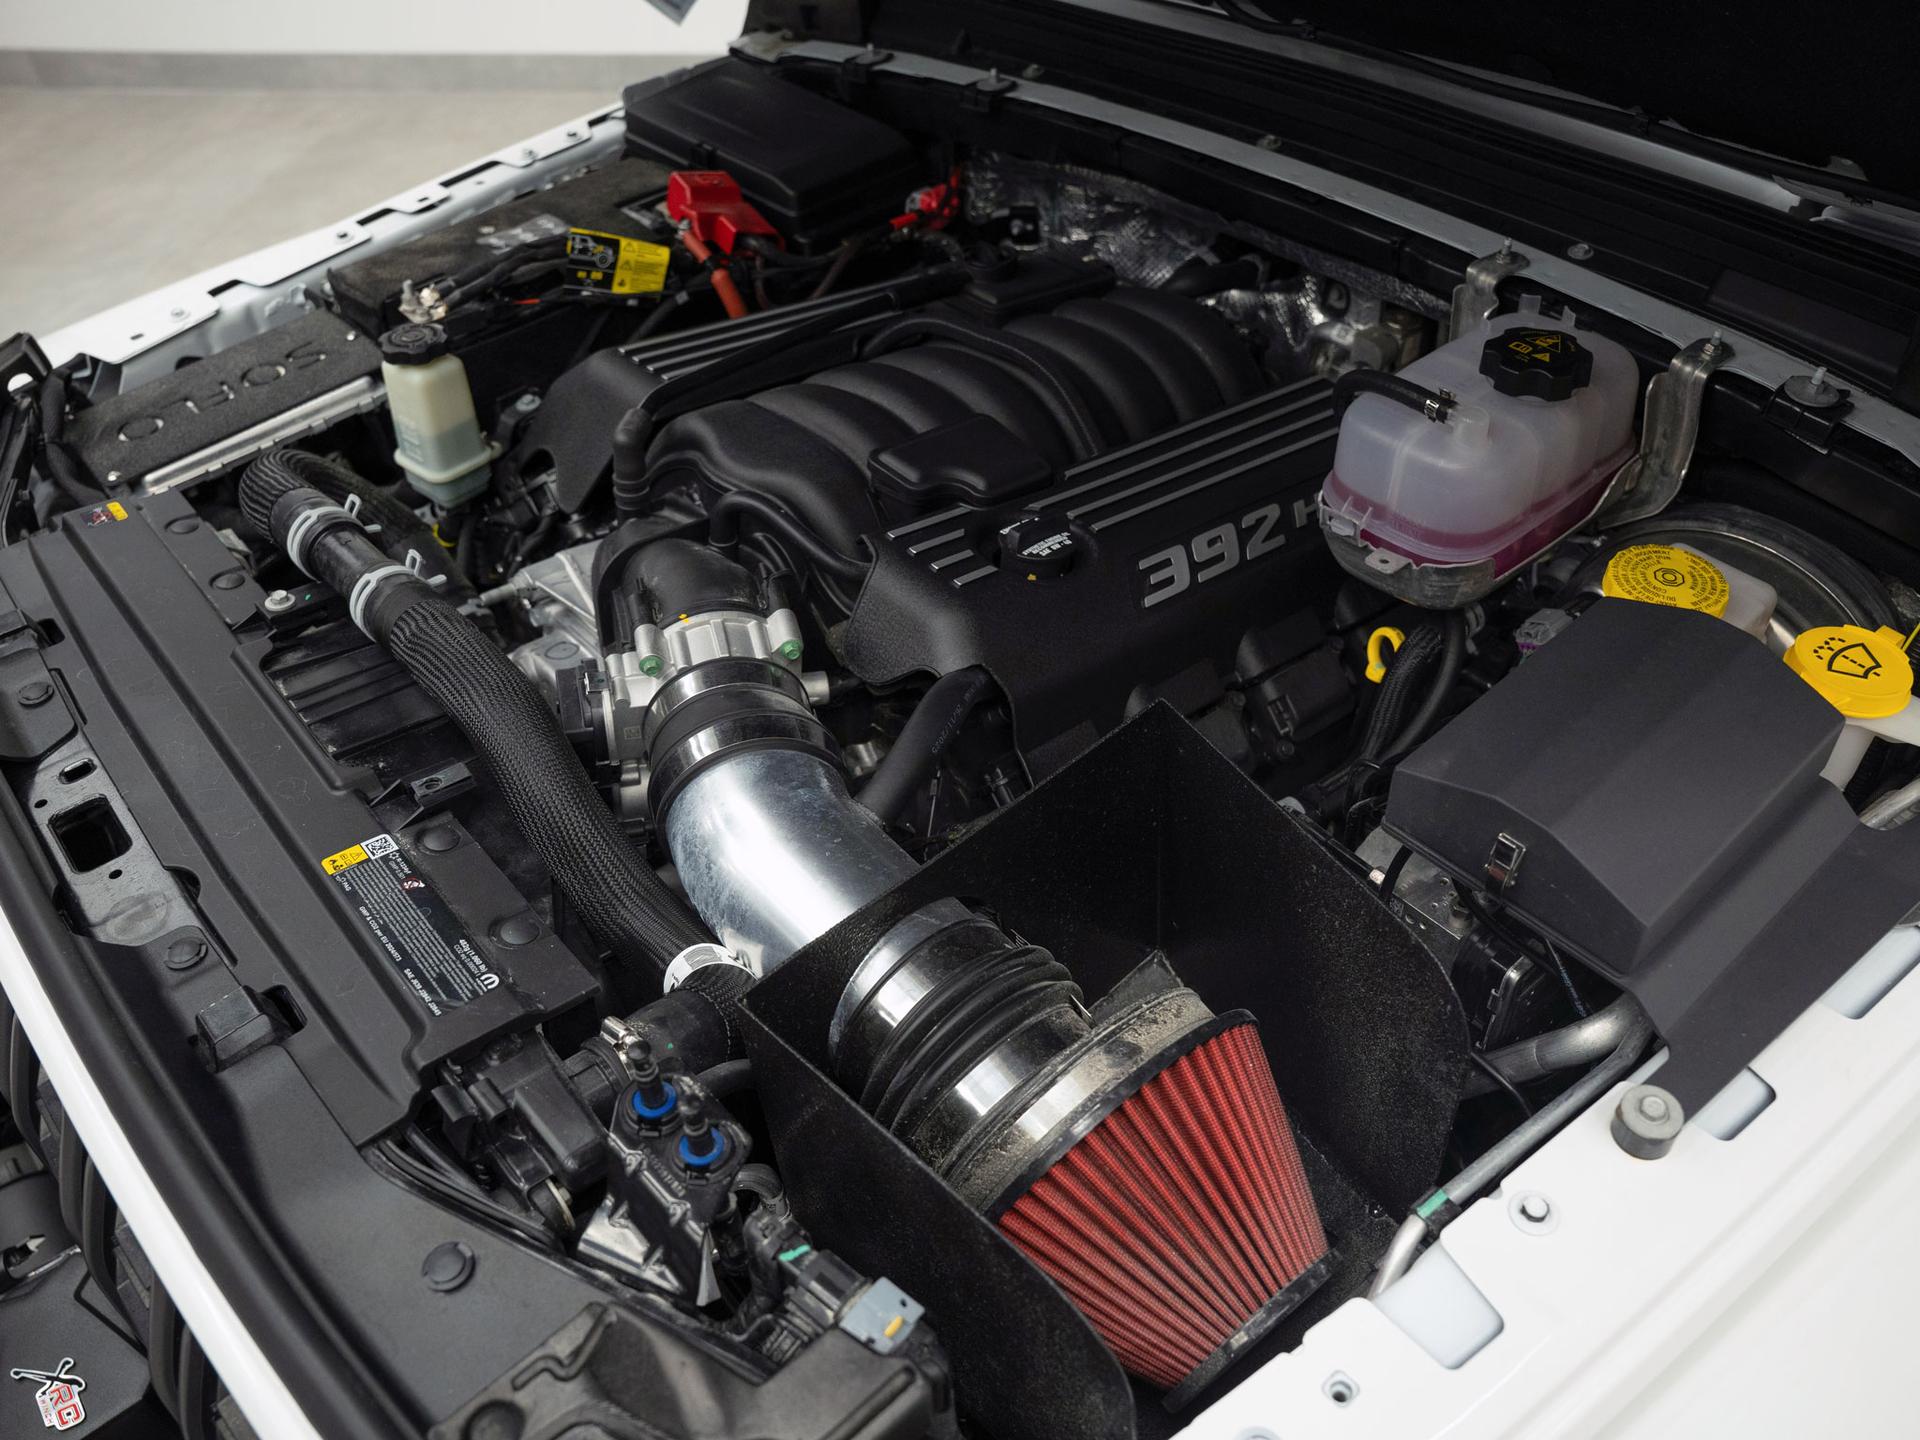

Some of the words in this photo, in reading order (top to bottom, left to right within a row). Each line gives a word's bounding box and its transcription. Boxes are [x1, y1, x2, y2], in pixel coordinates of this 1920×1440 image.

[1138, 503, 1287, 608] 392
[357, 905, 369, 917] GWP
[367, 919, 378, 929] CO2
[379, 935, 389, 943] EU
[402, 968, 414, 979] SAE
